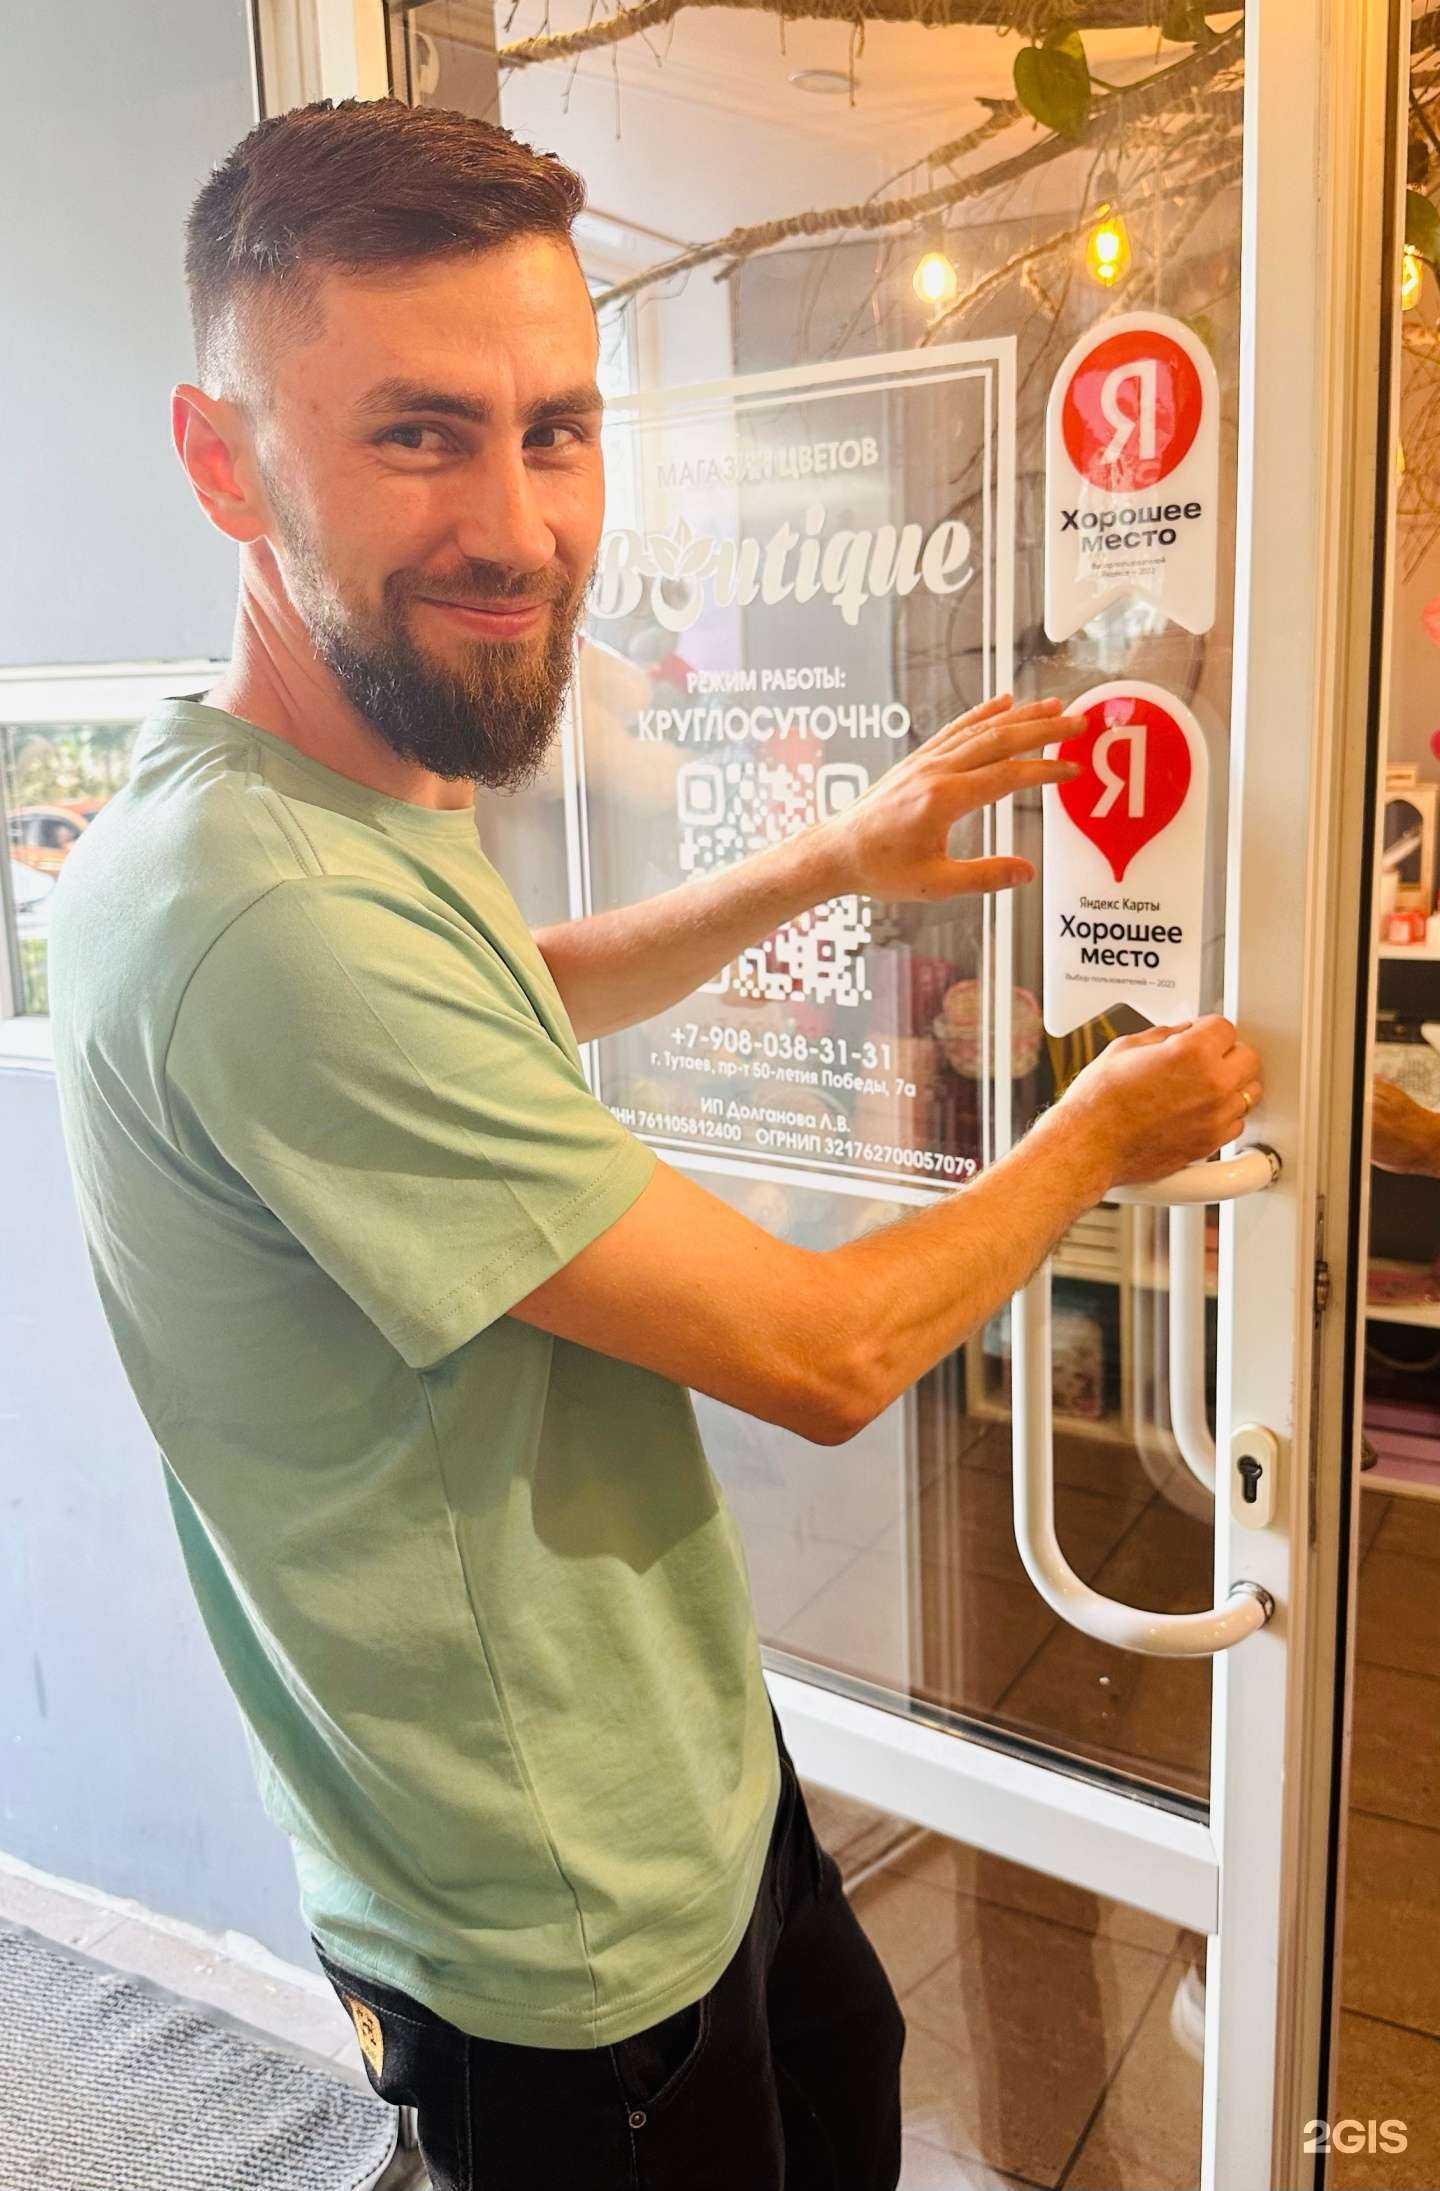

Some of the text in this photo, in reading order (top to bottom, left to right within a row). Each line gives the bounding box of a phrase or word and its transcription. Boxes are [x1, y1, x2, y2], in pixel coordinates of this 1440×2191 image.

[1101, 358, 1157, 464] Я
[776, 437, 879, 480] ЦВЕТОВ
[1060, 501, 1202, 532] Хорошее
[1081, 527, 1177, 553] место
[586, 503, 973, 632] Boutique
[687, 666, 846, 693] РЕЖИМ РАБОТЫ:
[637, 702, 911, 742] КРУГЛОСУТОЧНО
[1090, 725, 1147, 818] Я
[1079, 896, 1160, 914] Яндекс Карты
[1060, 914, 1183, 945] Хорошее
[1080, 947, 1160, 969] место
[671, 1024, 891, 1070] +7-908-038-31-31
[651, 1051, 917, 1097] г. Тутаев, пр-т 50-летия Победы, 7а
[701, 1097, 851, 1133] ИП Долганова Л.В.
[639, 1110, 742, 1141] 761105812400
[756, 1128, 821, 1153] ОГРНИП
[825, 1138, 977, 1176] 321762700057079
